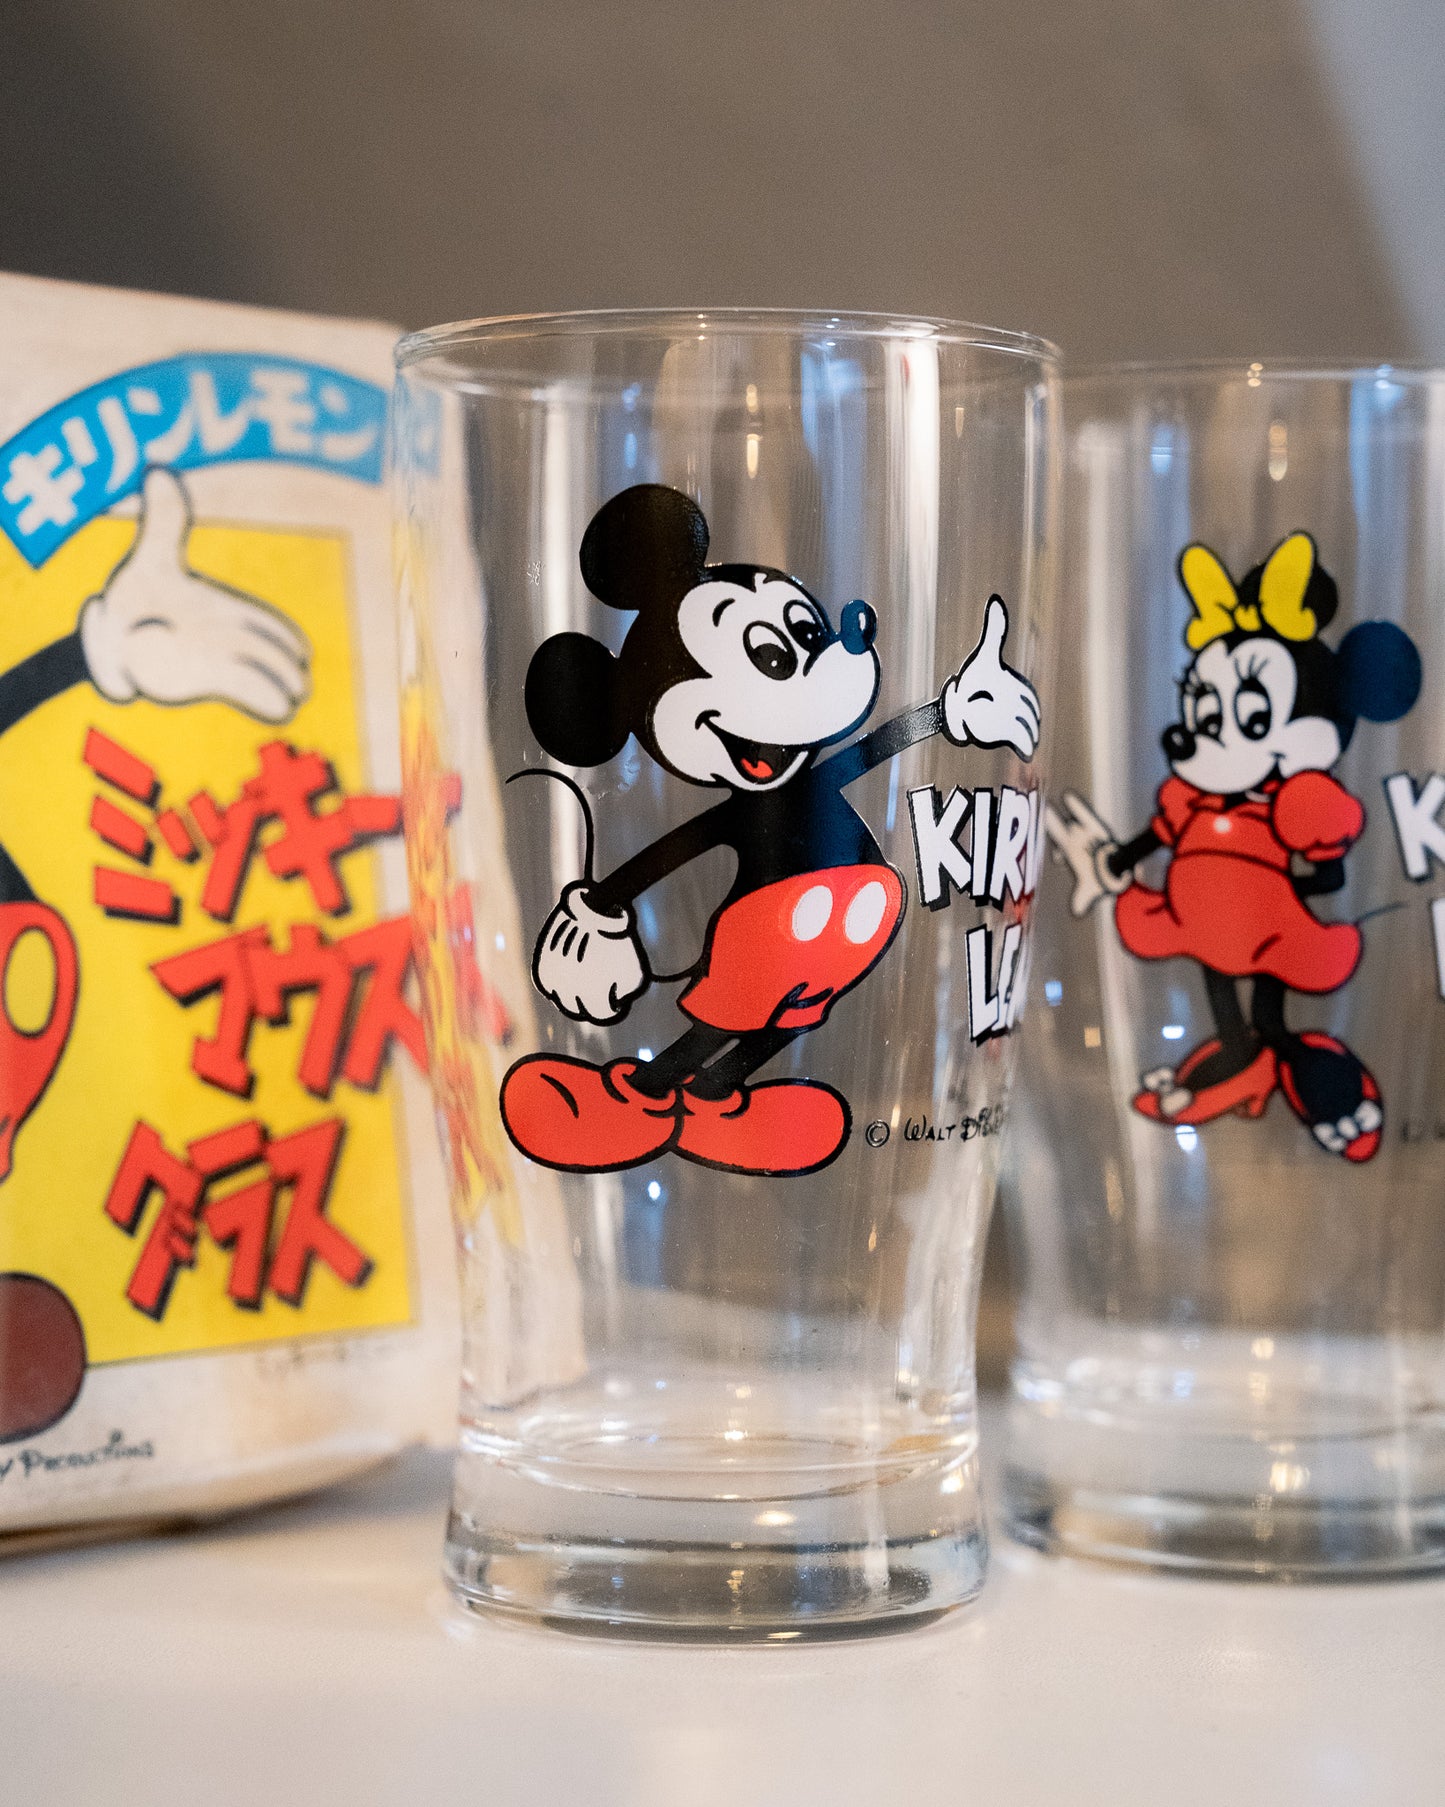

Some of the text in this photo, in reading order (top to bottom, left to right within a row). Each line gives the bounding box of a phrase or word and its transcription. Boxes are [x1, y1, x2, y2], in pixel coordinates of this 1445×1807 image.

[2, 370, 377, 536] キリンレモン
[83, 726, 405, 924] ミッキー
[149, 914, 430, 1100] マウス
[104, 1118, 373, 1321] グラス
